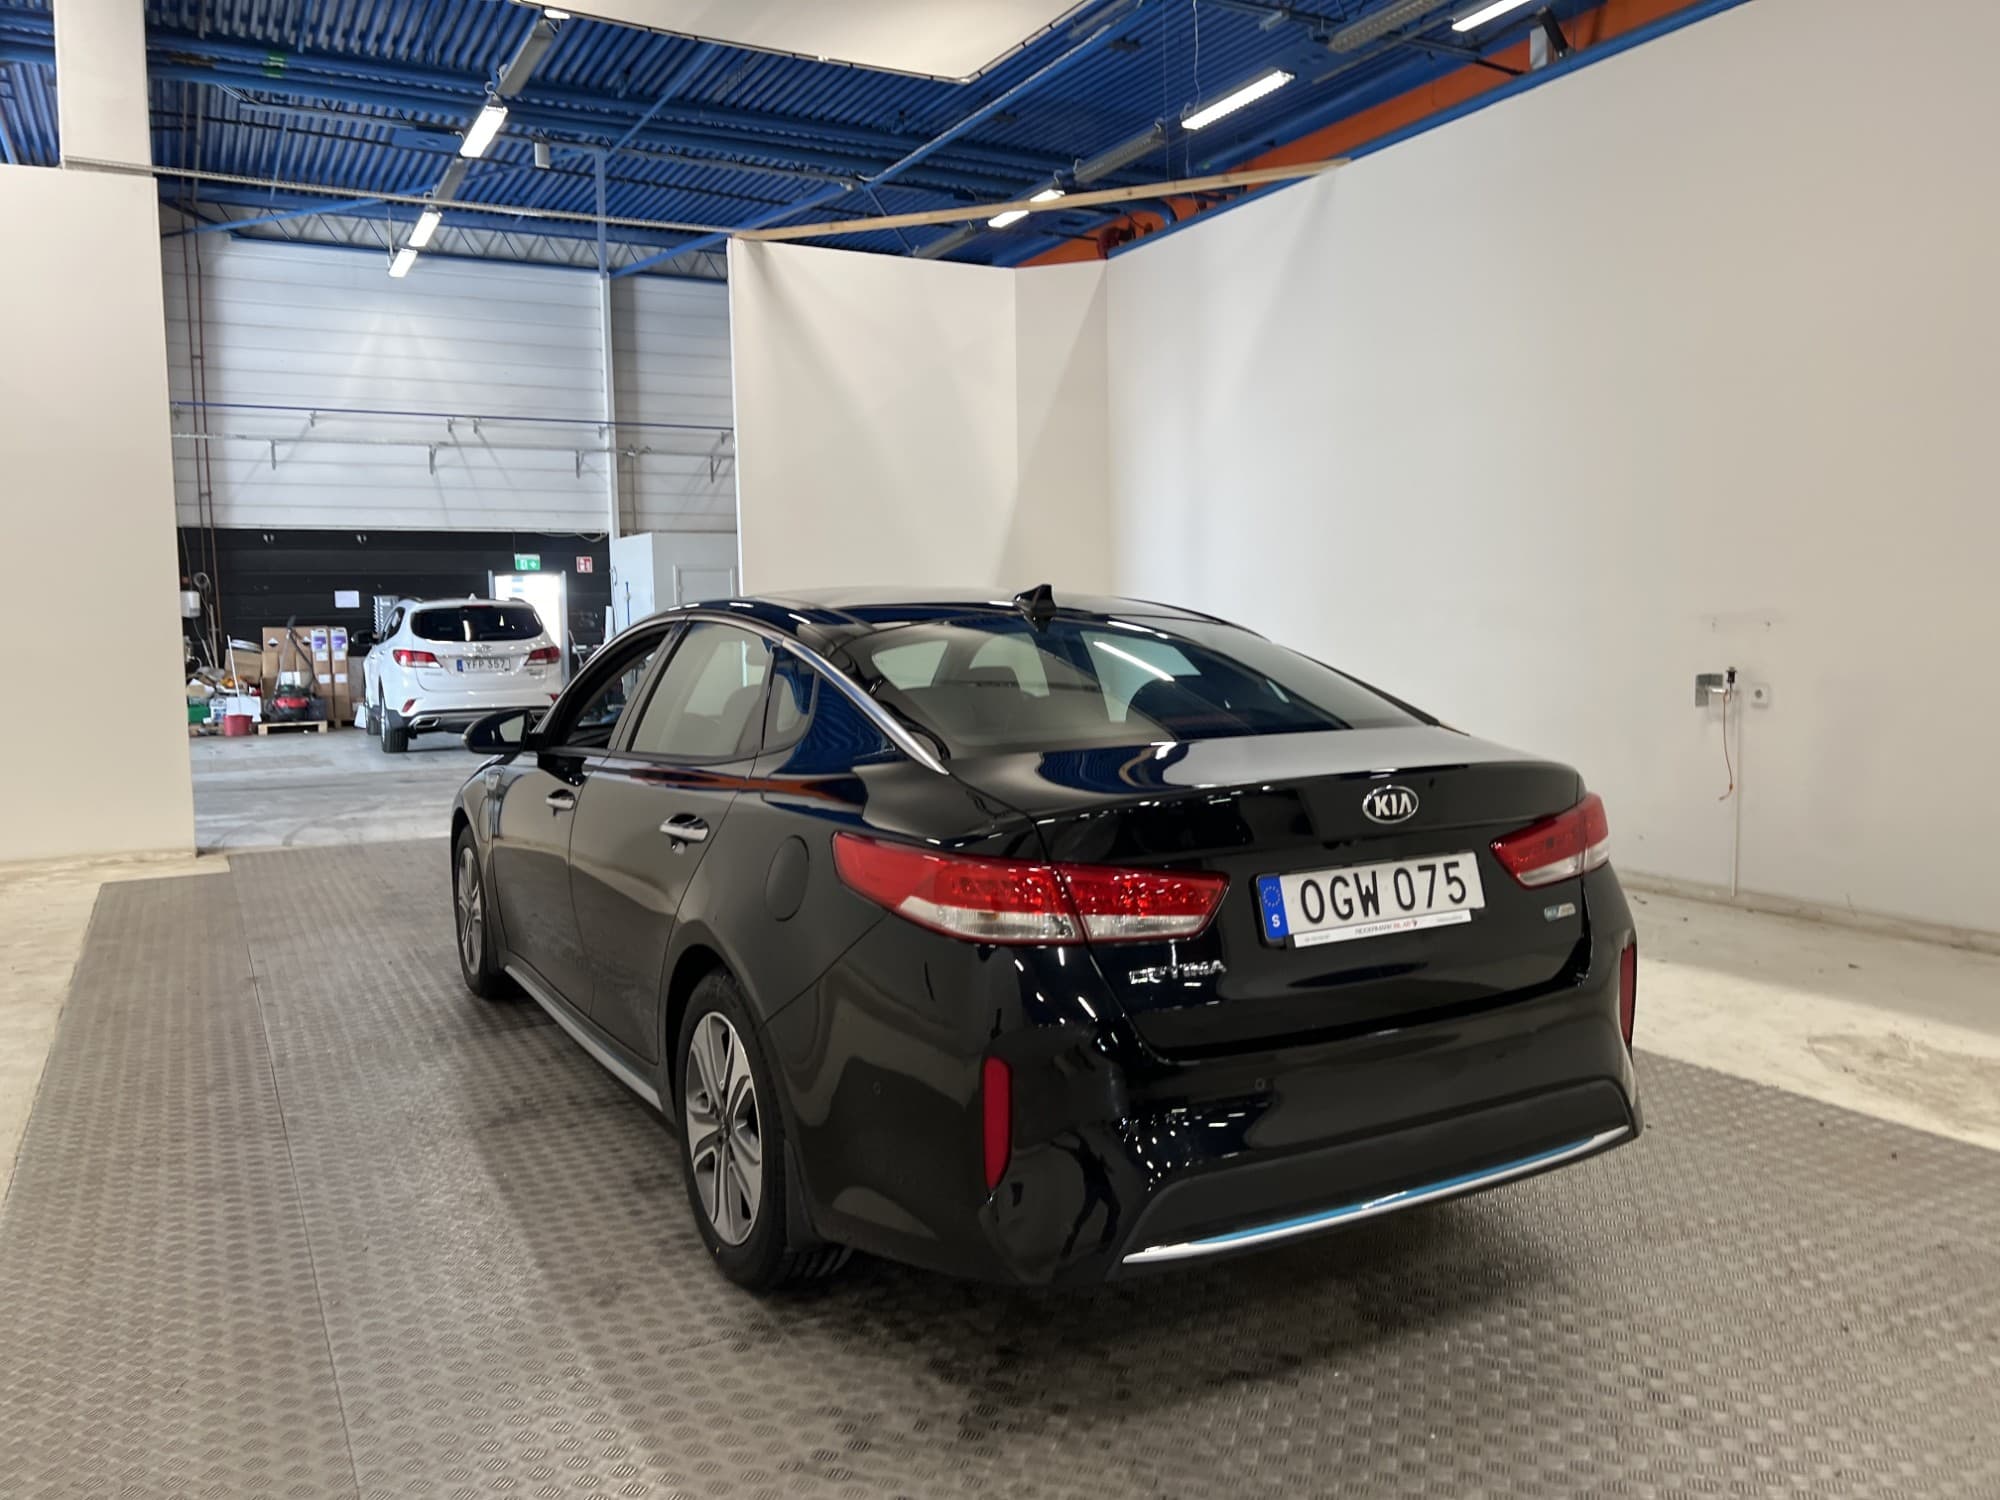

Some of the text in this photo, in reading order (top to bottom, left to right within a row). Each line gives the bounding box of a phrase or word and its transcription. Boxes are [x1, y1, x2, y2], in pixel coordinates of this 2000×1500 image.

[1373, 792, 1412, 817] KIA
[1300, 861, 1467, 924] OGW 075
[1271, 914, 1281, 928] S
